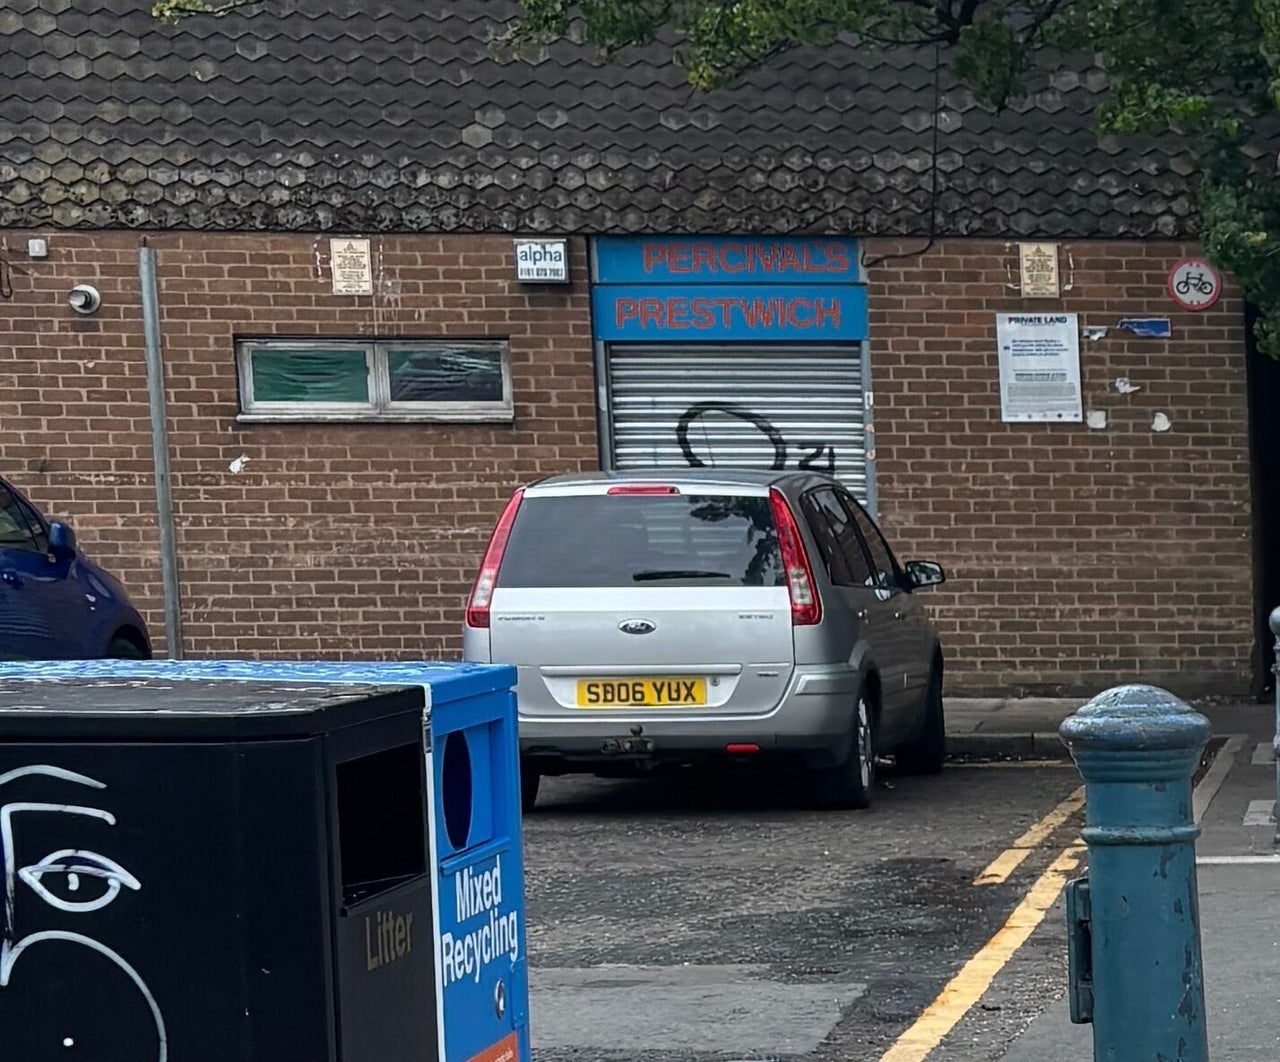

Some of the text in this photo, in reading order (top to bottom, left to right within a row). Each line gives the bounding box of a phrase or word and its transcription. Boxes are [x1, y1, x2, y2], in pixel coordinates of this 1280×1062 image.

[519, 245, 562, 265] alpha
[642, 240, 849, 273] PERCIVAL'S
[615, 297, 841, 330] PRESTWICH
[1044, 316, 1068, 324] LAND
[652, 681, 696, 702] YUX
[454, 854, 502, 924] Mixed
[365, 910, 413, 972] Litter
[441, 909, 519, 988] Recycling
